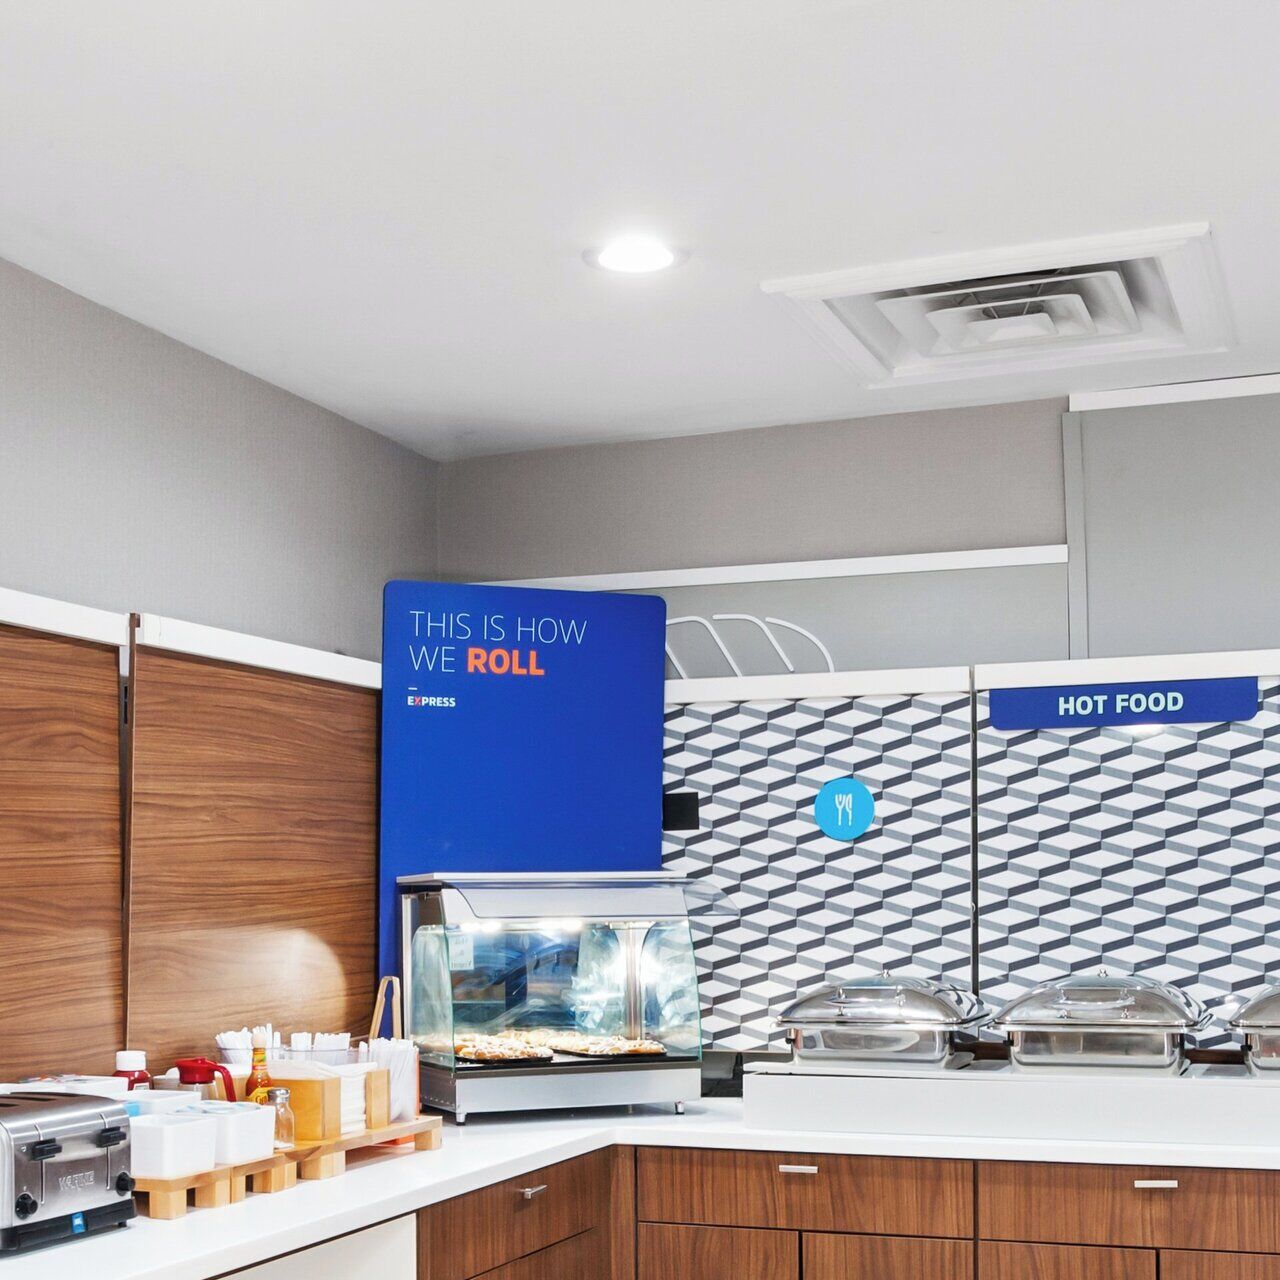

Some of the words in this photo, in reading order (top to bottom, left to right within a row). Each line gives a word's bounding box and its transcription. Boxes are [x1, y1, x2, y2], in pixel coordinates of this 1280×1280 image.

[409, 611, 471, 640] THIS
[484, 615, 505, 641] IS
[517, 617, 587, 644] HOW
[409, 645, 455, 672] WE
[467, 647, 545, 676] ROLL
[407, 696, 456, 707] EXPRESS
[1059, 694, 1108, 715] HOT
[1116, 691, 1184, 713] FOOD
